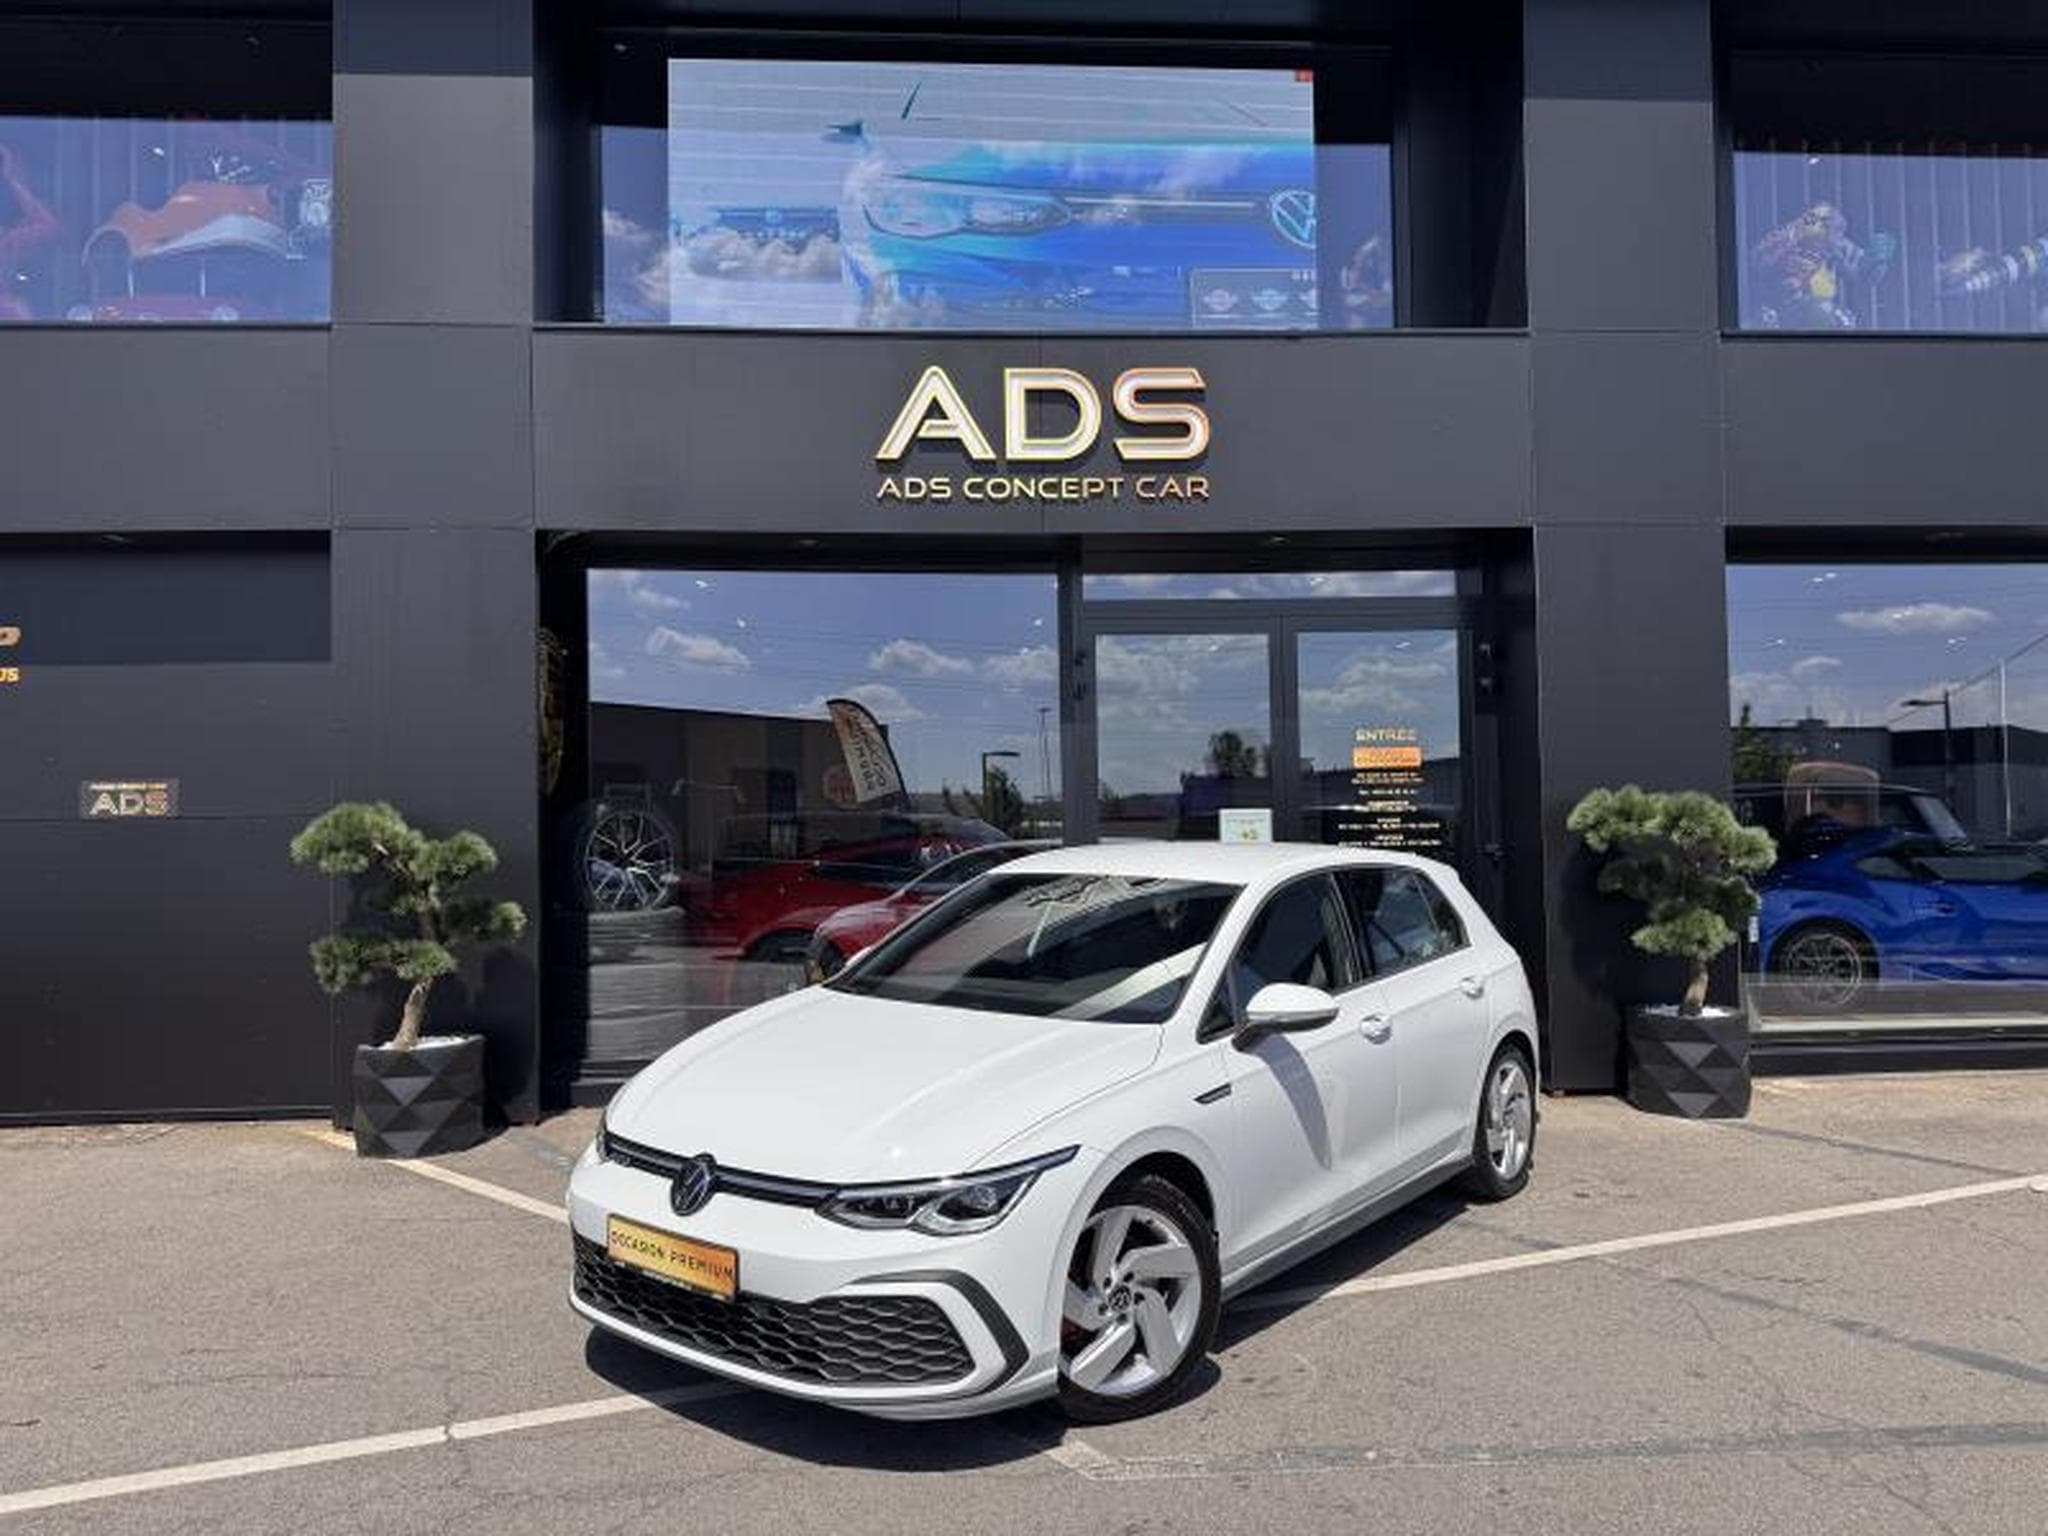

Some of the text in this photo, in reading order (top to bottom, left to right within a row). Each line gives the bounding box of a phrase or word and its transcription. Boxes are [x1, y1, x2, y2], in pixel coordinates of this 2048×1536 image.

[874, 364, 1211, 462] ADS
[876, 476, 1211, 500] ADS CONCEPT CAR
[89, 792, 168, 816] ADS
[611, 1230, 665, 1258] OCCASION
[670, 1251, 733, 1280] PREMIUM
